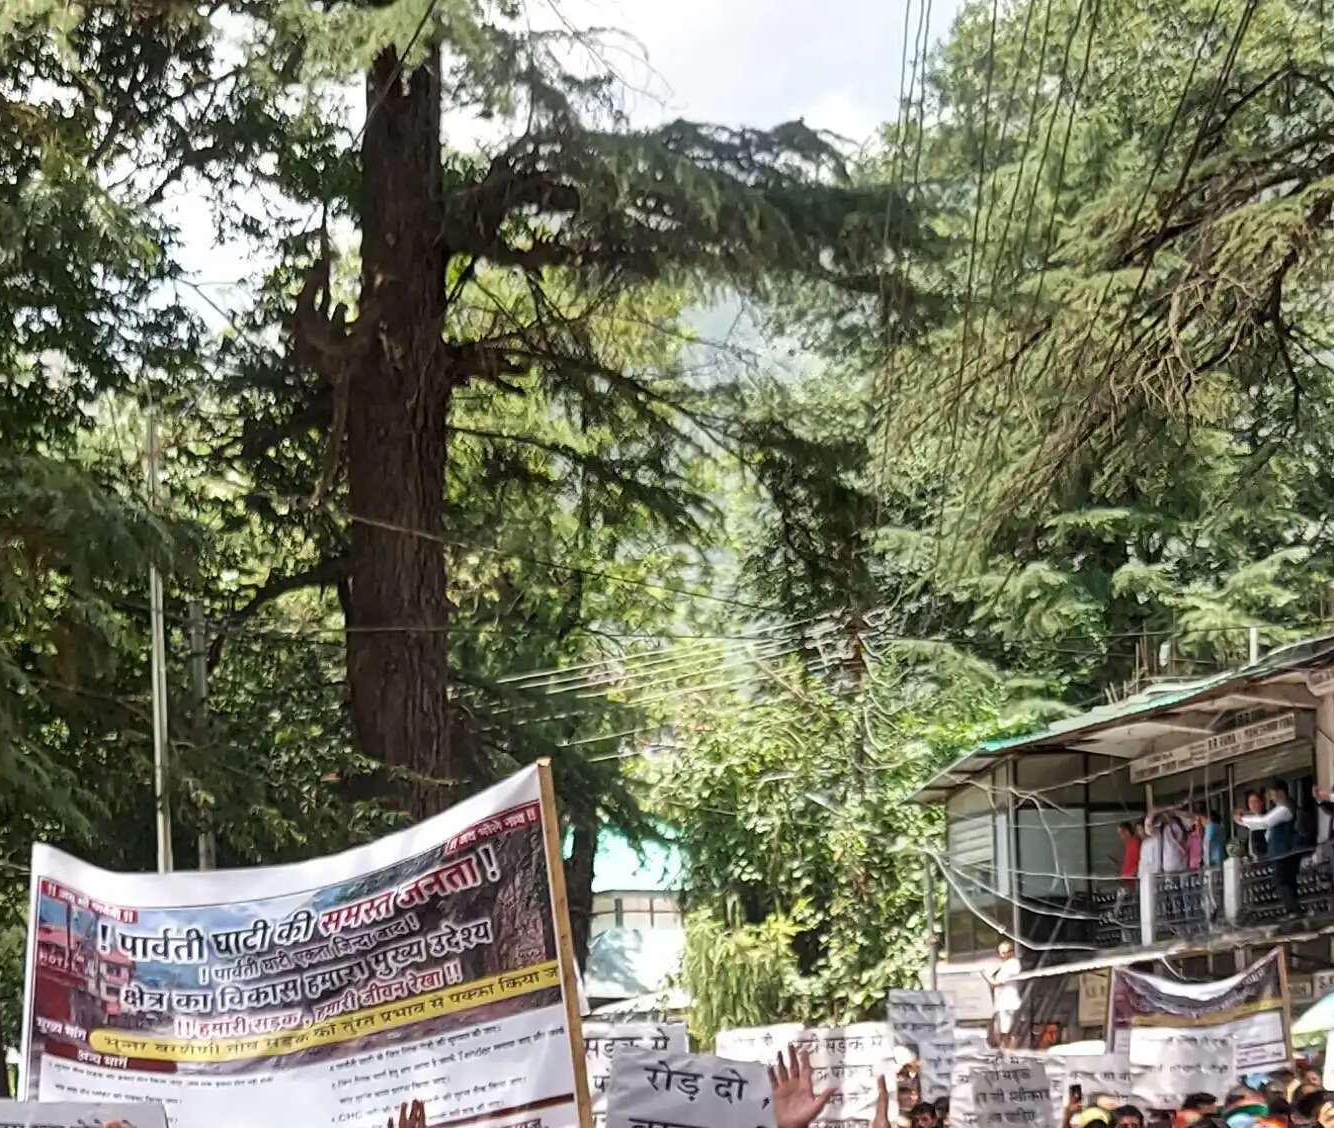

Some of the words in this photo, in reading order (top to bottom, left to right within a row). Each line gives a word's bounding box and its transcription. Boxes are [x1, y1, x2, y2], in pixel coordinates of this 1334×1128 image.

[119, 928, 204, 961] पार्वती
[213, 918, 270, 954] घाटी
[275, 909, 313, 945] की
[320, 891, 394, 936] समस्त
[397, 857, 479, 908] जनता
[122, 984, 167, 1013] क्षेत्र
[173, 990, 211, 1013] का
[218, 976, 301, 1011] विकास
[306, 959, 367, 998] हमारा
[370, 939, 425, 977] मुख्य
[213, 960, 261, 981] पार्वती
[263, 952, 293, 975] घाटी
[360, 979, 407, 1007] जीवन
[408, 969, 443, 994] रेखा
[379, 1002, 427, 1024] प्रभाव
[498, 970, 541, 993] किया
[457, 1046, 492, 1062] Tender
[643, 1060, 705, 1102] रोड़
[712, 1068, 748, 1105] दो
